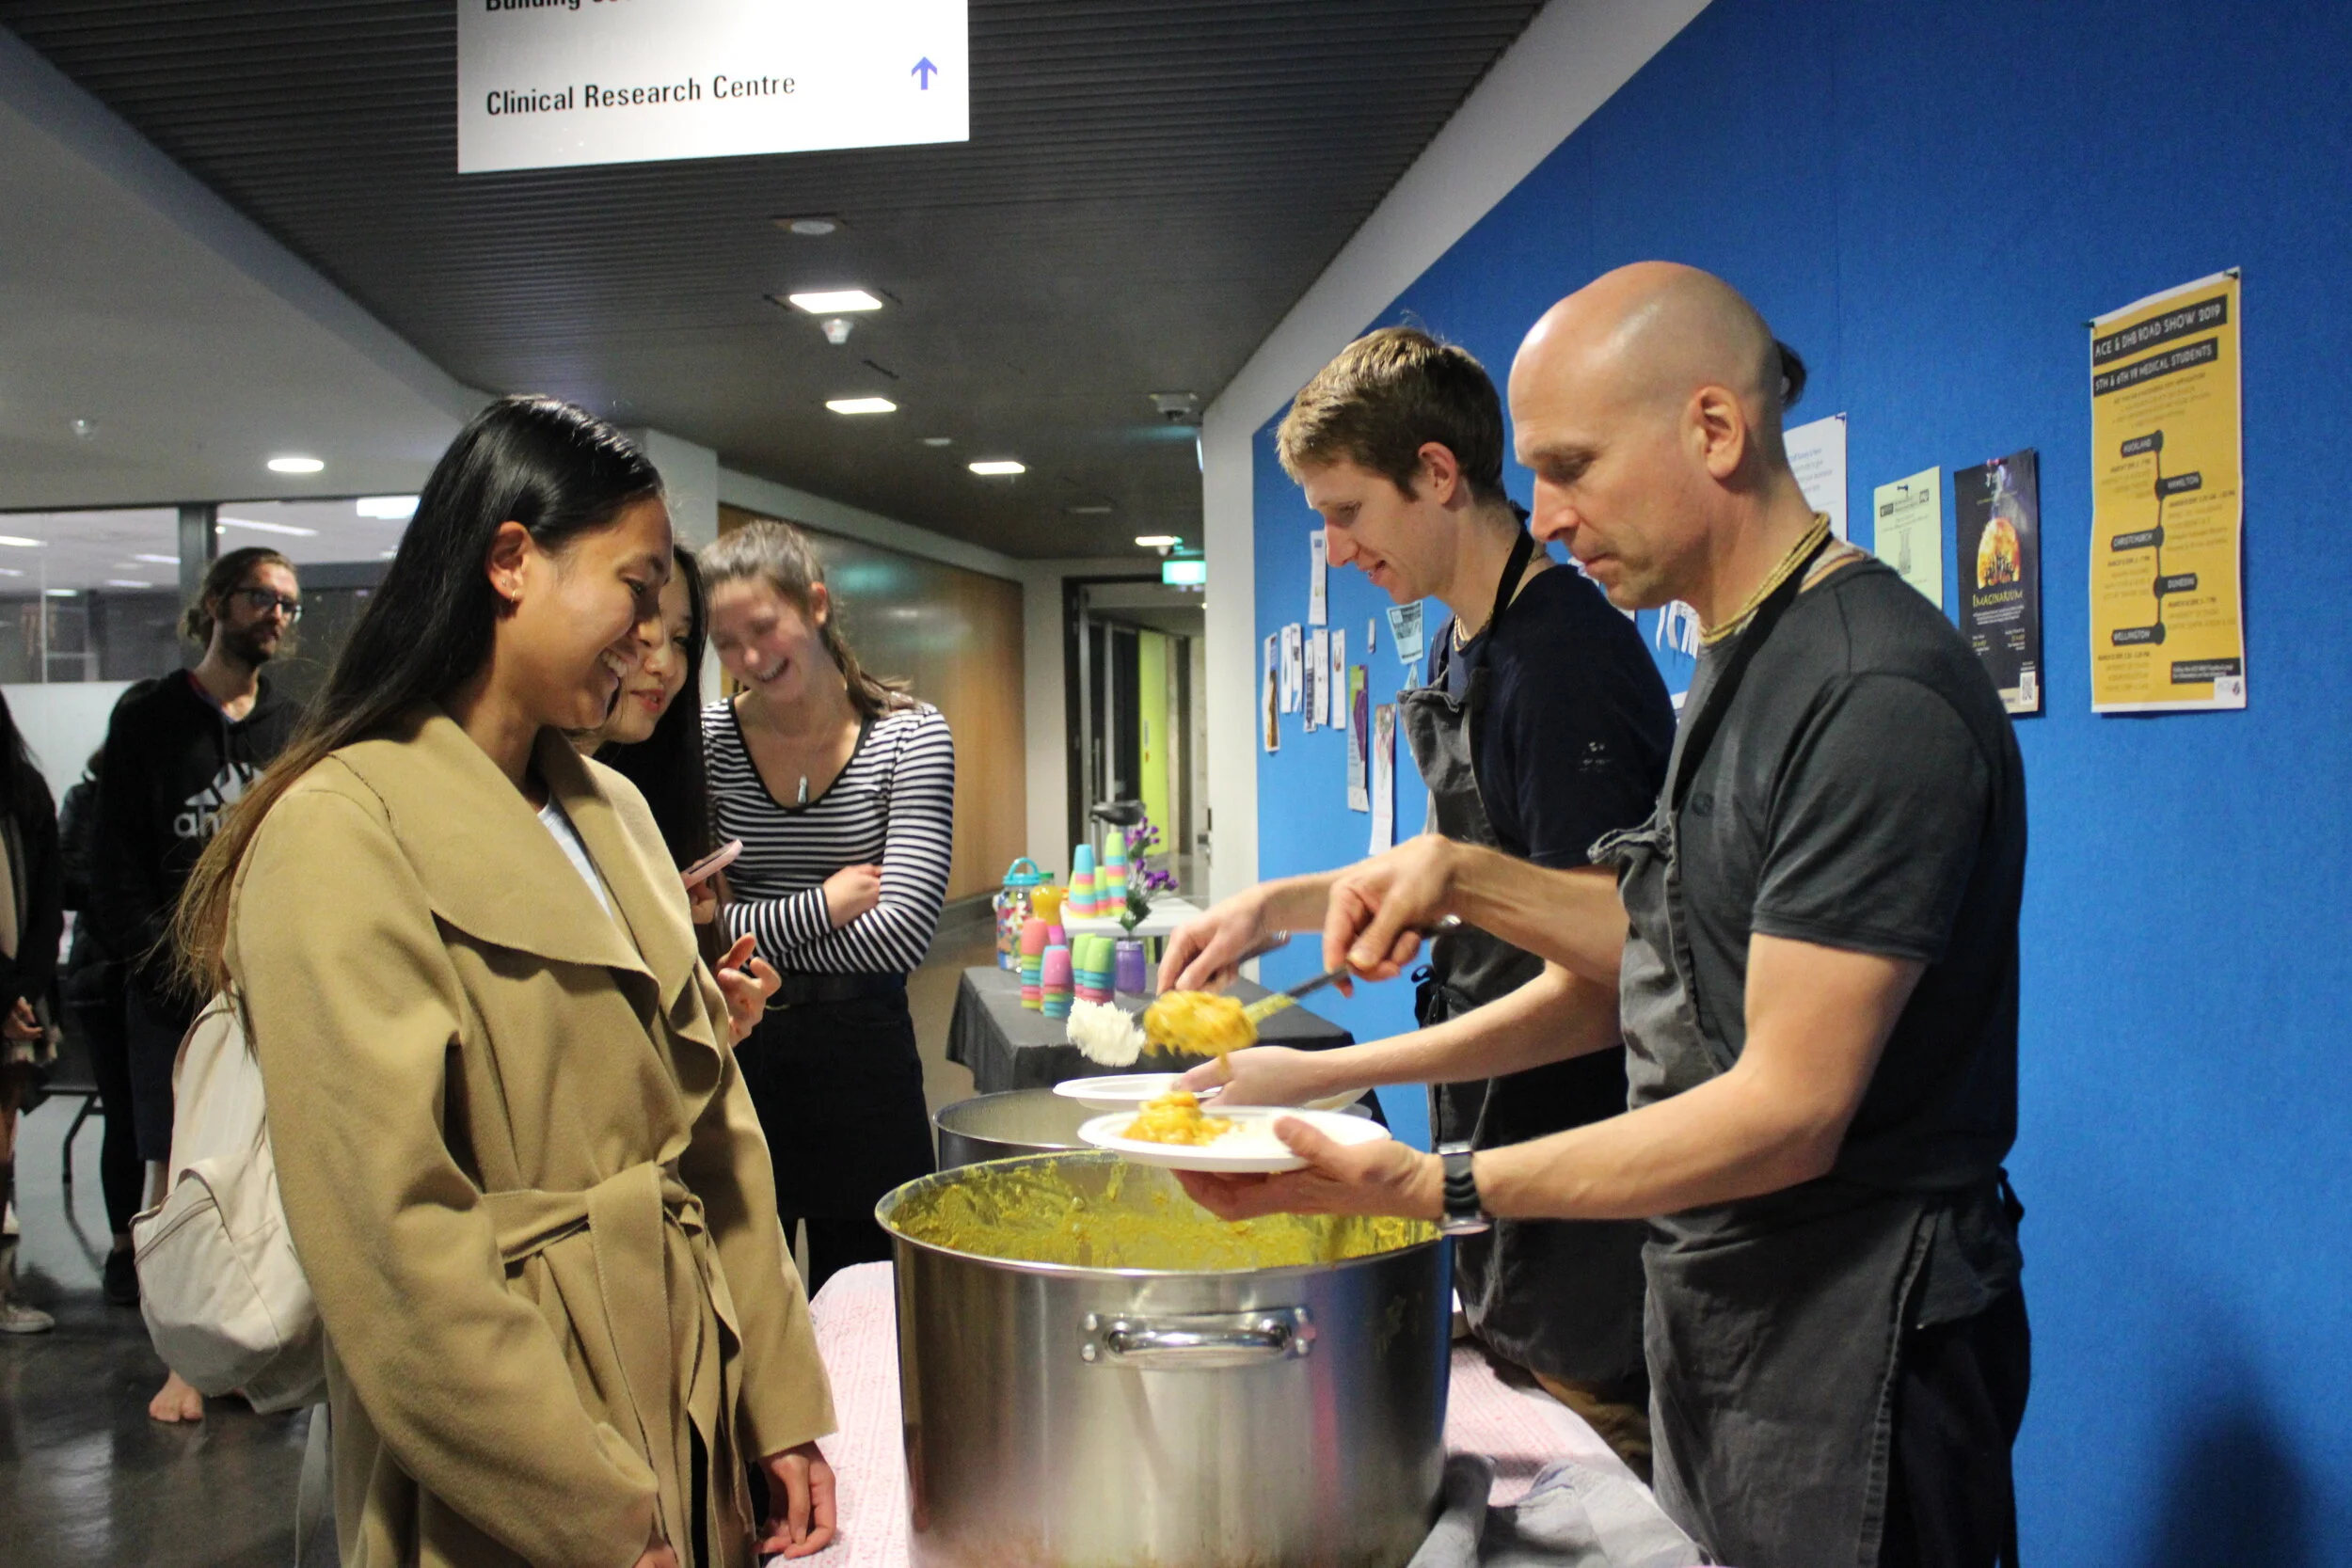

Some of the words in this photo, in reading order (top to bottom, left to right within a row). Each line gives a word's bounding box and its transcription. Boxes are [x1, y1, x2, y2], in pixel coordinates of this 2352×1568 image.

[485, 87, 574, 116] Clinical
[584, 78, 701, 108] Research
[713, 74, 796, 99] Centre
[2094, 340, 2112, 357] ACE
[2122, 330, 2137, 349] DHB
[2138, 321, 2162, 341] ROAD
[2163, 310, 2196, 332] SHOW
[2198, 304, 2221, 322] 2019
[2139, 357, 2169, 377] MEDICAL
[2170, 344, 2213, 367] STUDENTS
